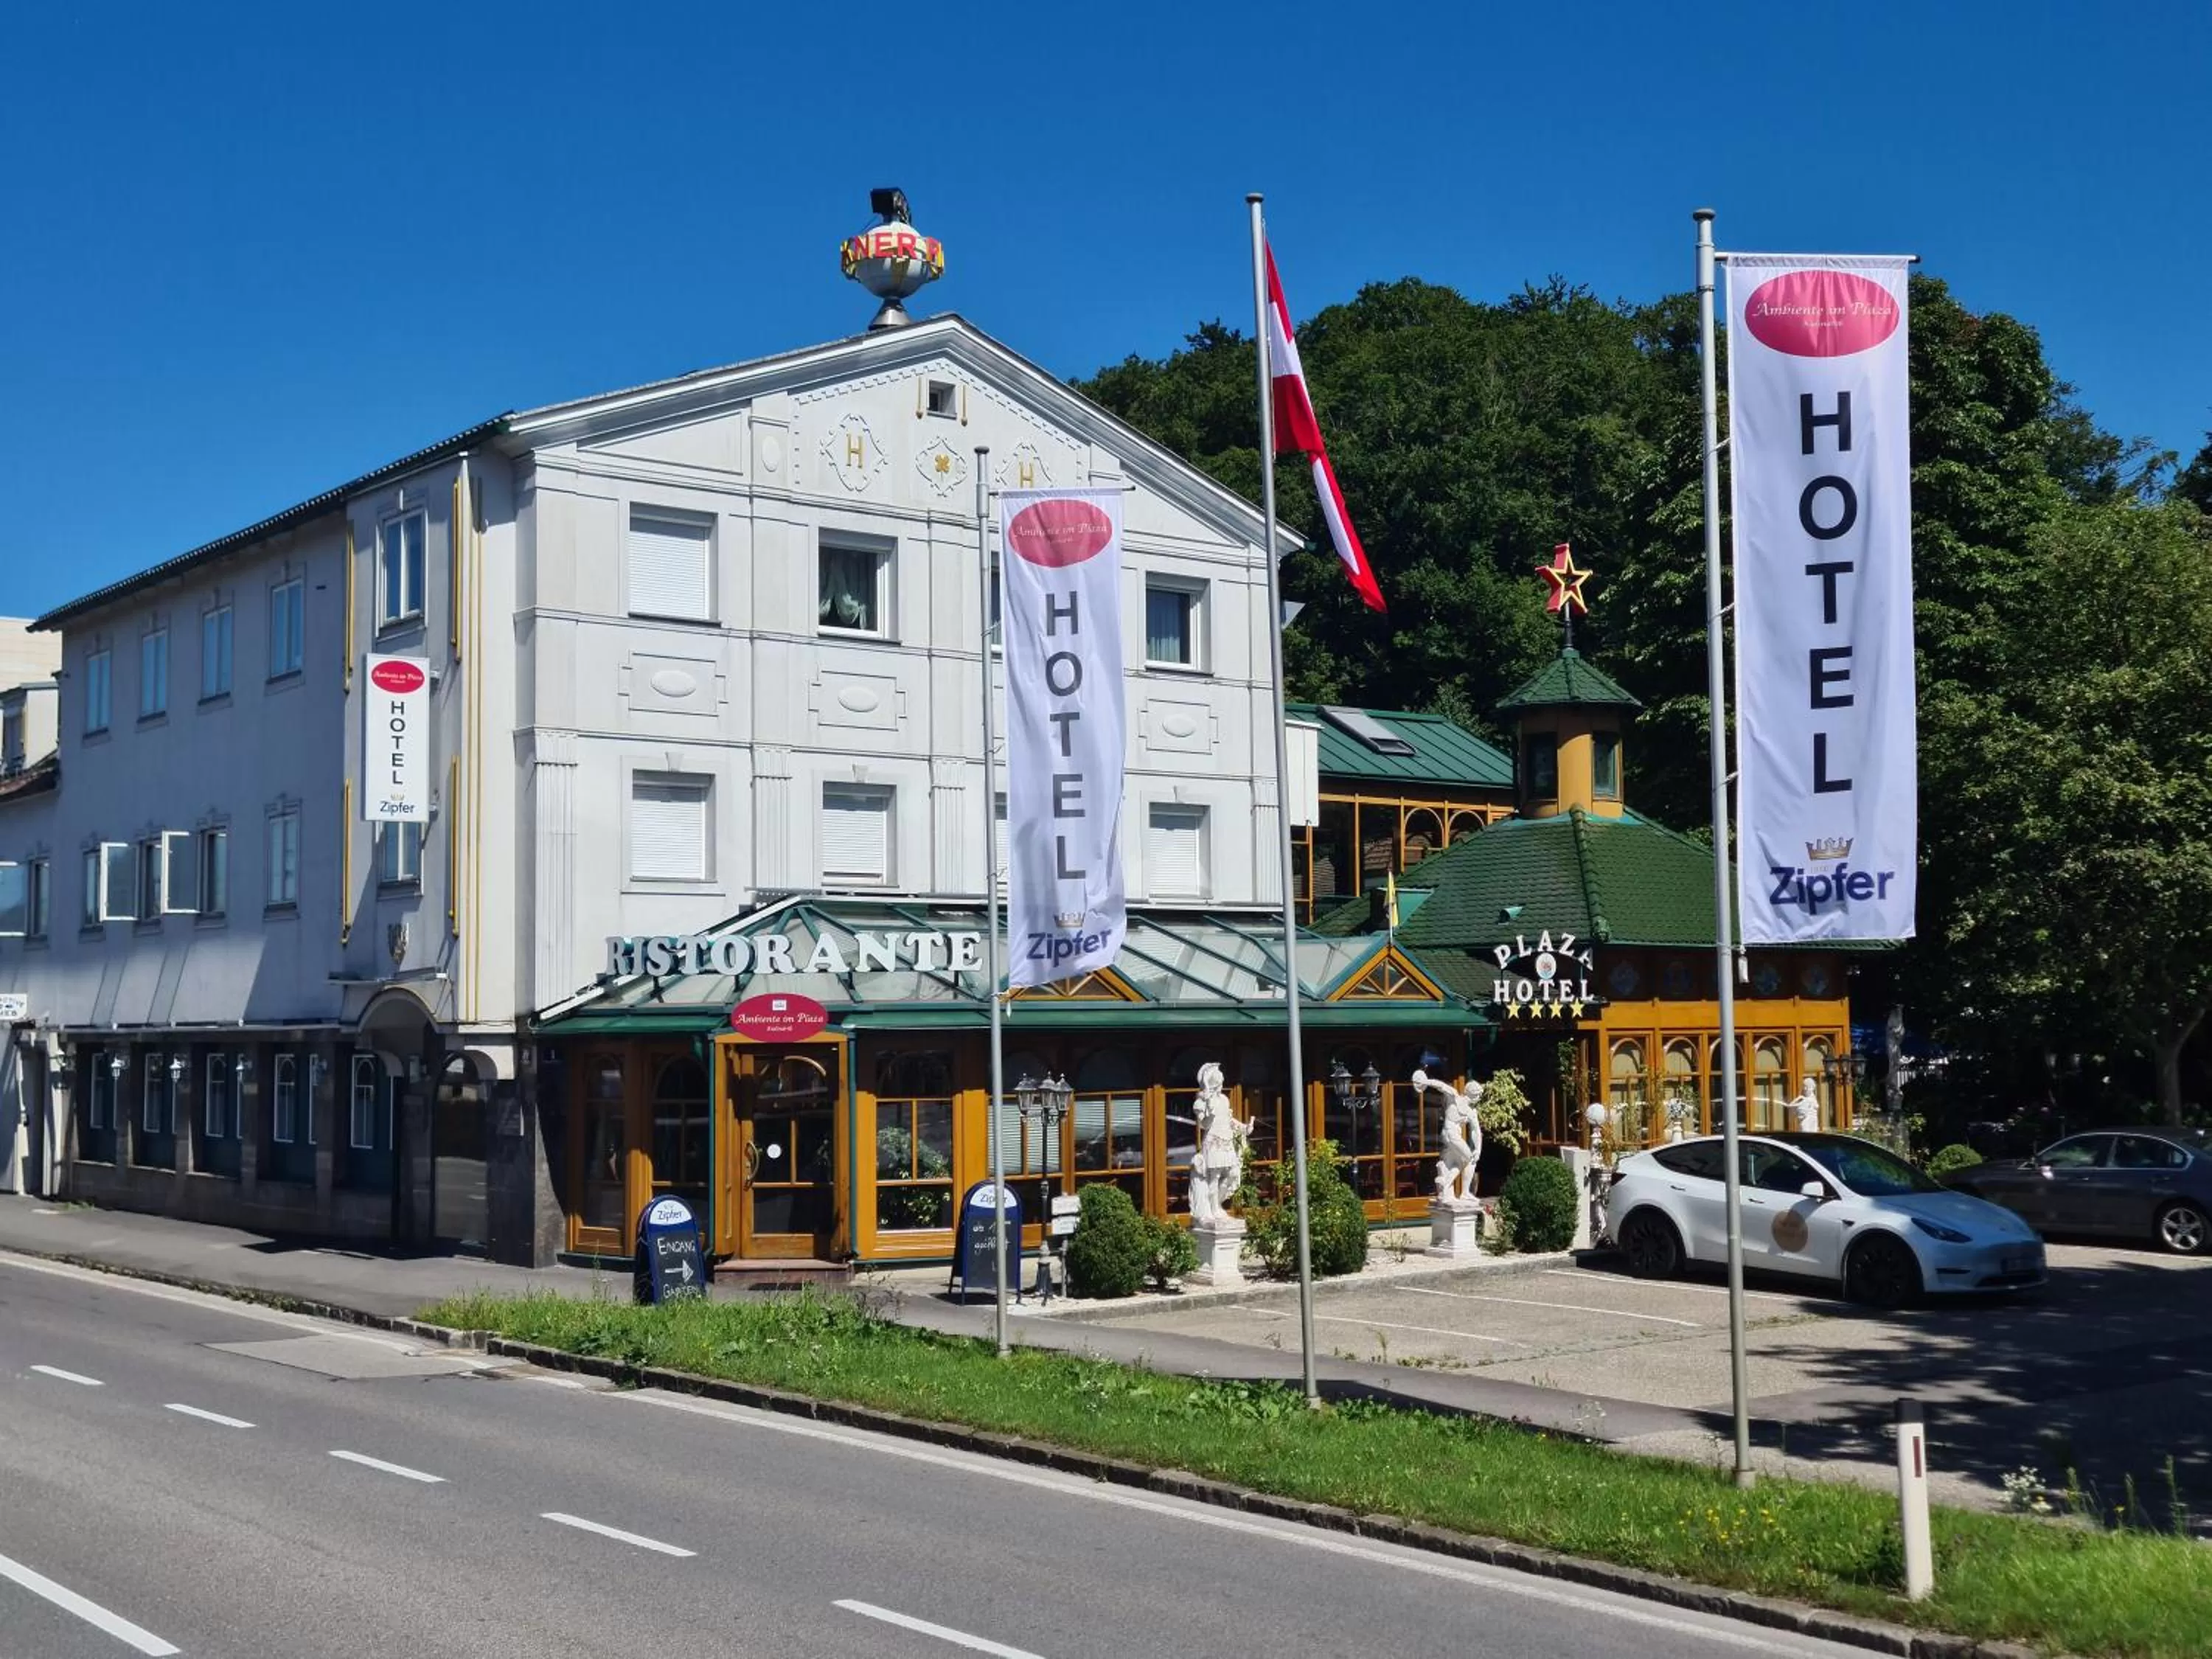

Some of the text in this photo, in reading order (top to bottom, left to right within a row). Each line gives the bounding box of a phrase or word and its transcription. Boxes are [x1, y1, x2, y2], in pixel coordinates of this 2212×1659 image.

[1752, 302, 1824, 317] Ambiente
[1850, 301, 1892, 316] Plaza
[846, 434, 863, 468] H
[1019, 462, 1034, 487] H
[1798, 391, 1858, 794] HOTEL
[390, 701, 406, 785] HOTEL
[1046, 591, 1086, 880] HOTEL
[380, 801, 414, 815] Zipfer
[1770, 862, 1894, 916] Zipfer
[605, 931, 984, 976] RISTORANTE
[1026, 929, 1113, 967] Zipfer
[1493, 930, 1593, 971] PLAZA
[1493, 979, 1594, 1002] HOTEL
[797, 1012, 824, 1023] Plaza
[657, 1210, 683, 1222] Zipfer
[980, 1193, 1008, 1205] Zipr
